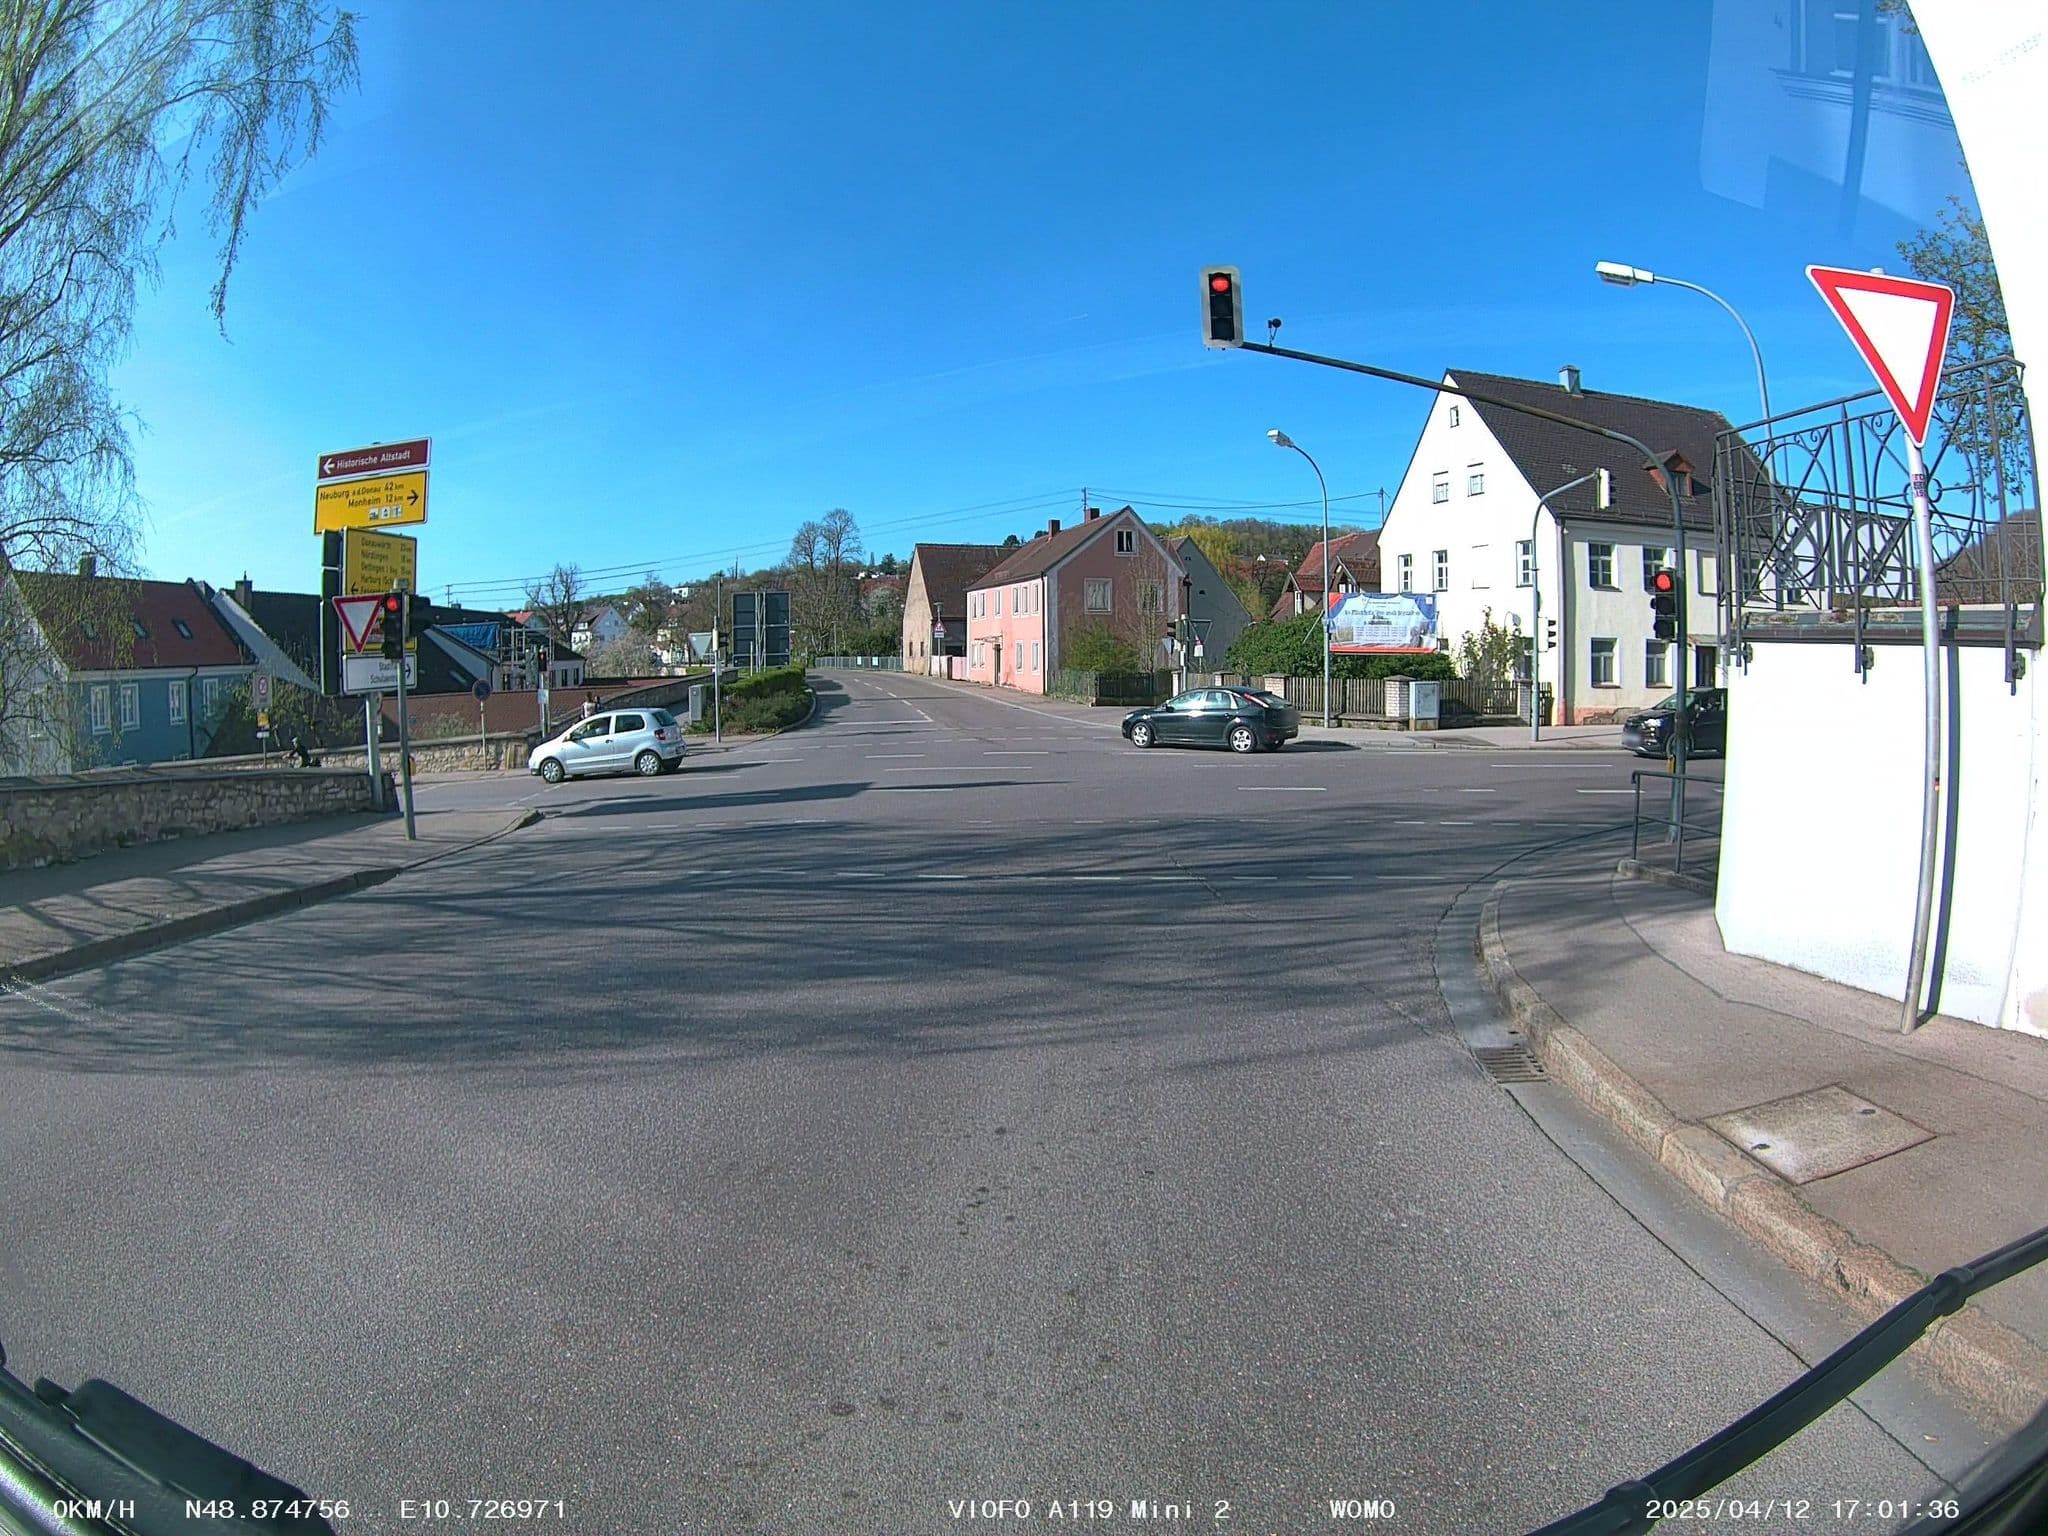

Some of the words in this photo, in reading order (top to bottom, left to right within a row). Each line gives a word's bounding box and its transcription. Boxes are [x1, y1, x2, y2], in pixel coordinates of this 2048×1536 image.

[336, 456, 378, 470] Historische
[380, 450, 411, 464] Altstadt
[320, 489, 350, 501] Neuburg
[384, 481, 393, 492] 42
[348, 497, 381, 508] Monheim
[385, 494, 393, 503] 12
